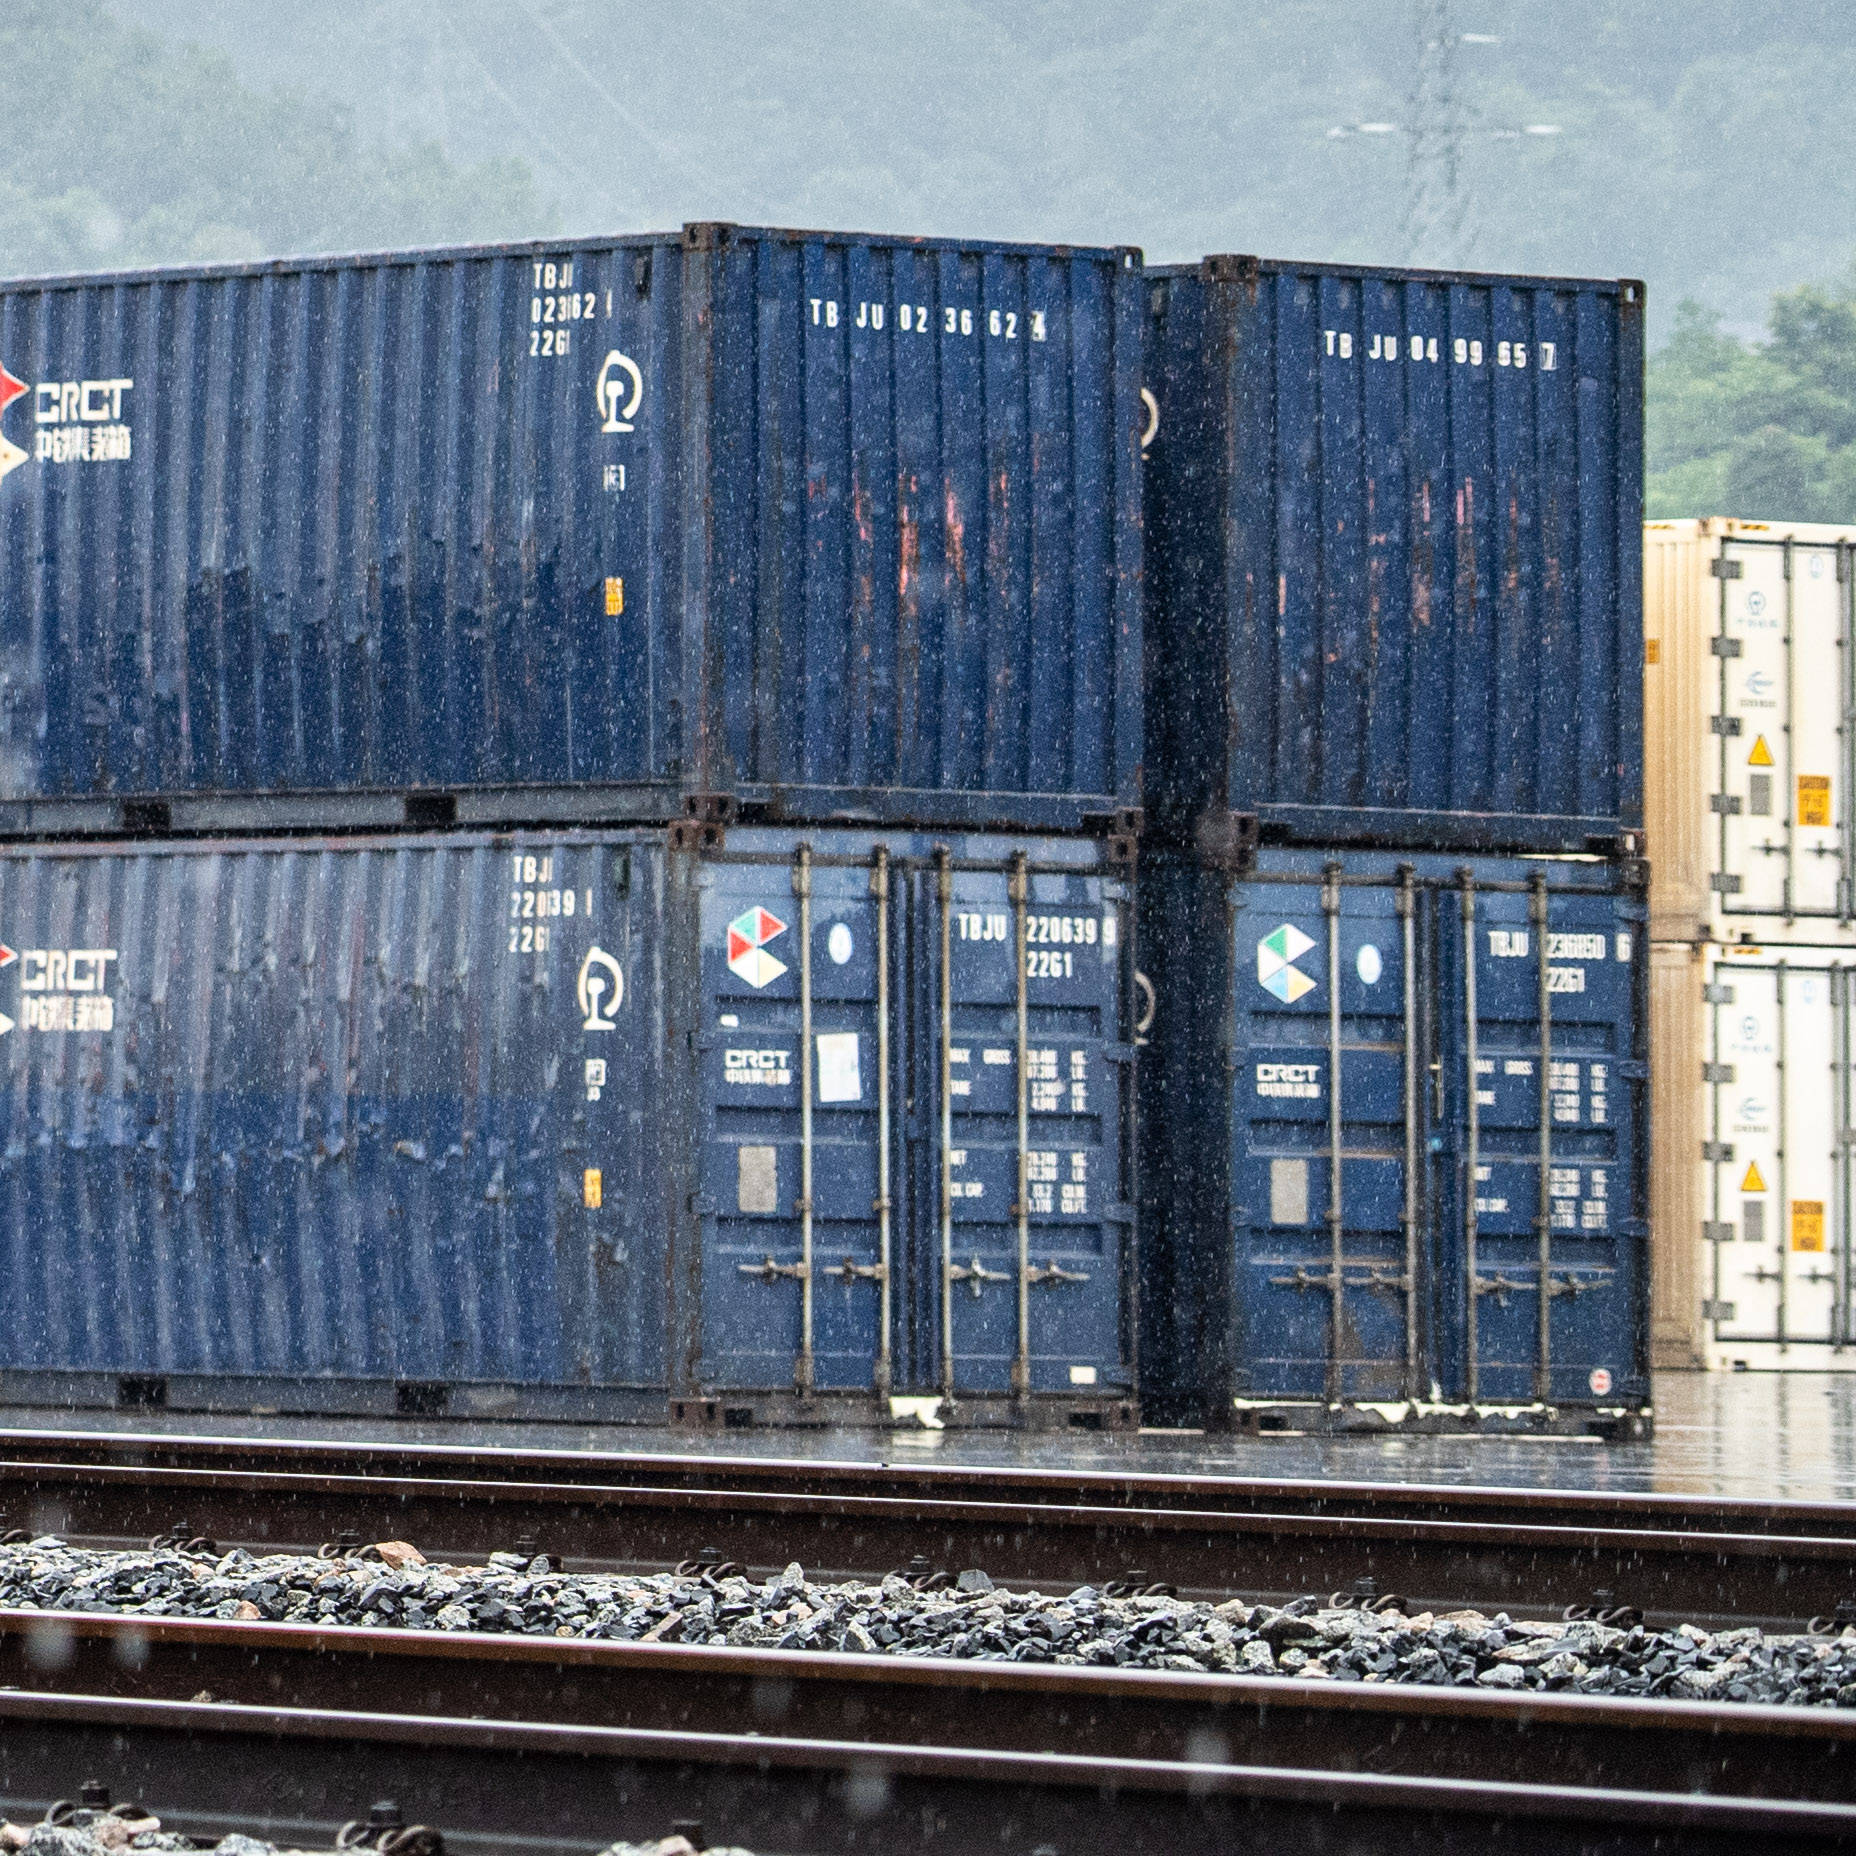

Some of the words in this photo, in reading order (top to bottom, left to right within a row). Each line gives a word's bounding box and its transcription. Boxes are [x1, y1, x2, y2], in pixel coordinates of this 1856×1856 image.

[530, 292, 596, 323] 02362
[34, 378, 134, 424] CRCT
[510, 889, 576, 918] 22039
[958, 912, 1007, 942] TBJU
[1025, 915, 1098, 945] 220639
[20, 948, 119, 991] CRCT
[724, 1049, 792, 1069] CRCT
[1256, 1063, 1321, 1083] CRCT
